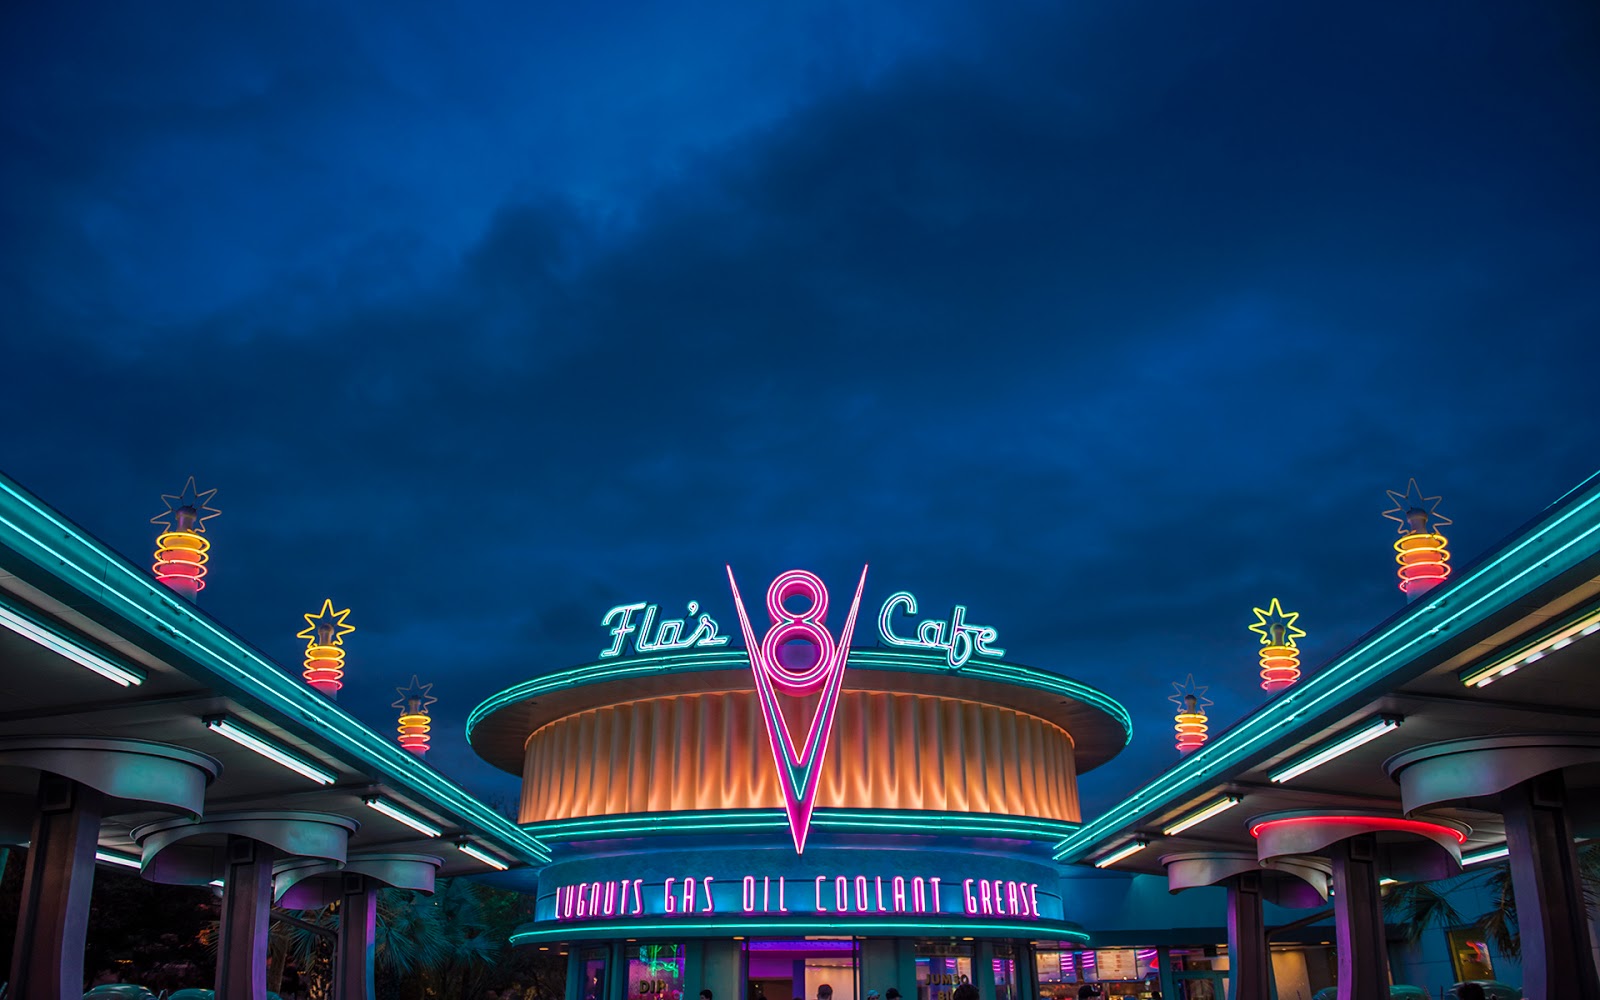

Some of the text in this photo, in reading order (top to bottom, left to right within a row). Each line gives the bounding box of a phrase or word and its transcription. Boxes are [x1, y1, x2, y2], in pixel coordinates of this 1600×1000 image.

[599, 600, 731, 659] Flo's
[878, 591, 1006, 669] Cafe
[555, 875, 1041, 919] LUGNUTS GAS OIL COOLANT GREASE
[925, 974, 969, 986] JUMBO
